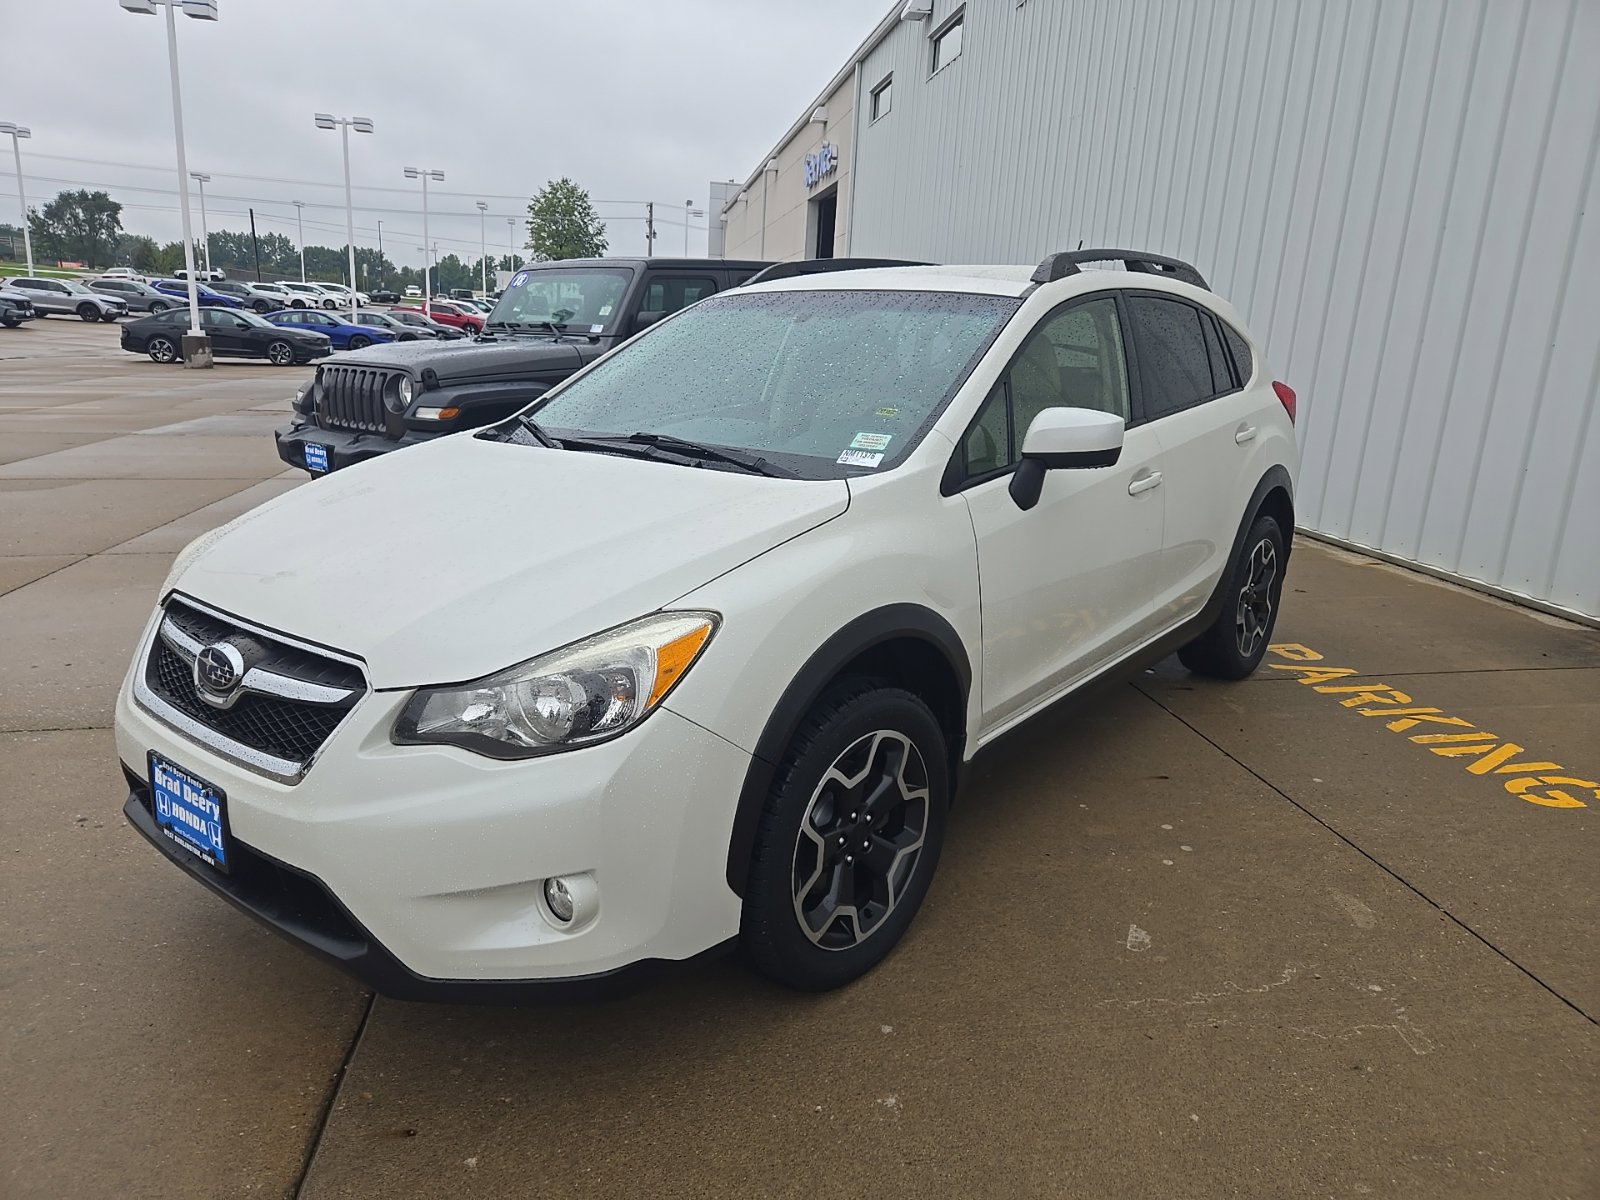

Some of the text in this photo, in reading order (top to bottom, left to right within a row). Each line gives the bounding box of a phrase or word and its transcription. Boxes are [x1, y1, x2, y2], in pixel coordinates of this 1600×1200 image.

[1266, 643, 1600, 809] PARKING
[154, 766, 220, 821] Brad Deery
[172, 802, 208, 836] HONDA
